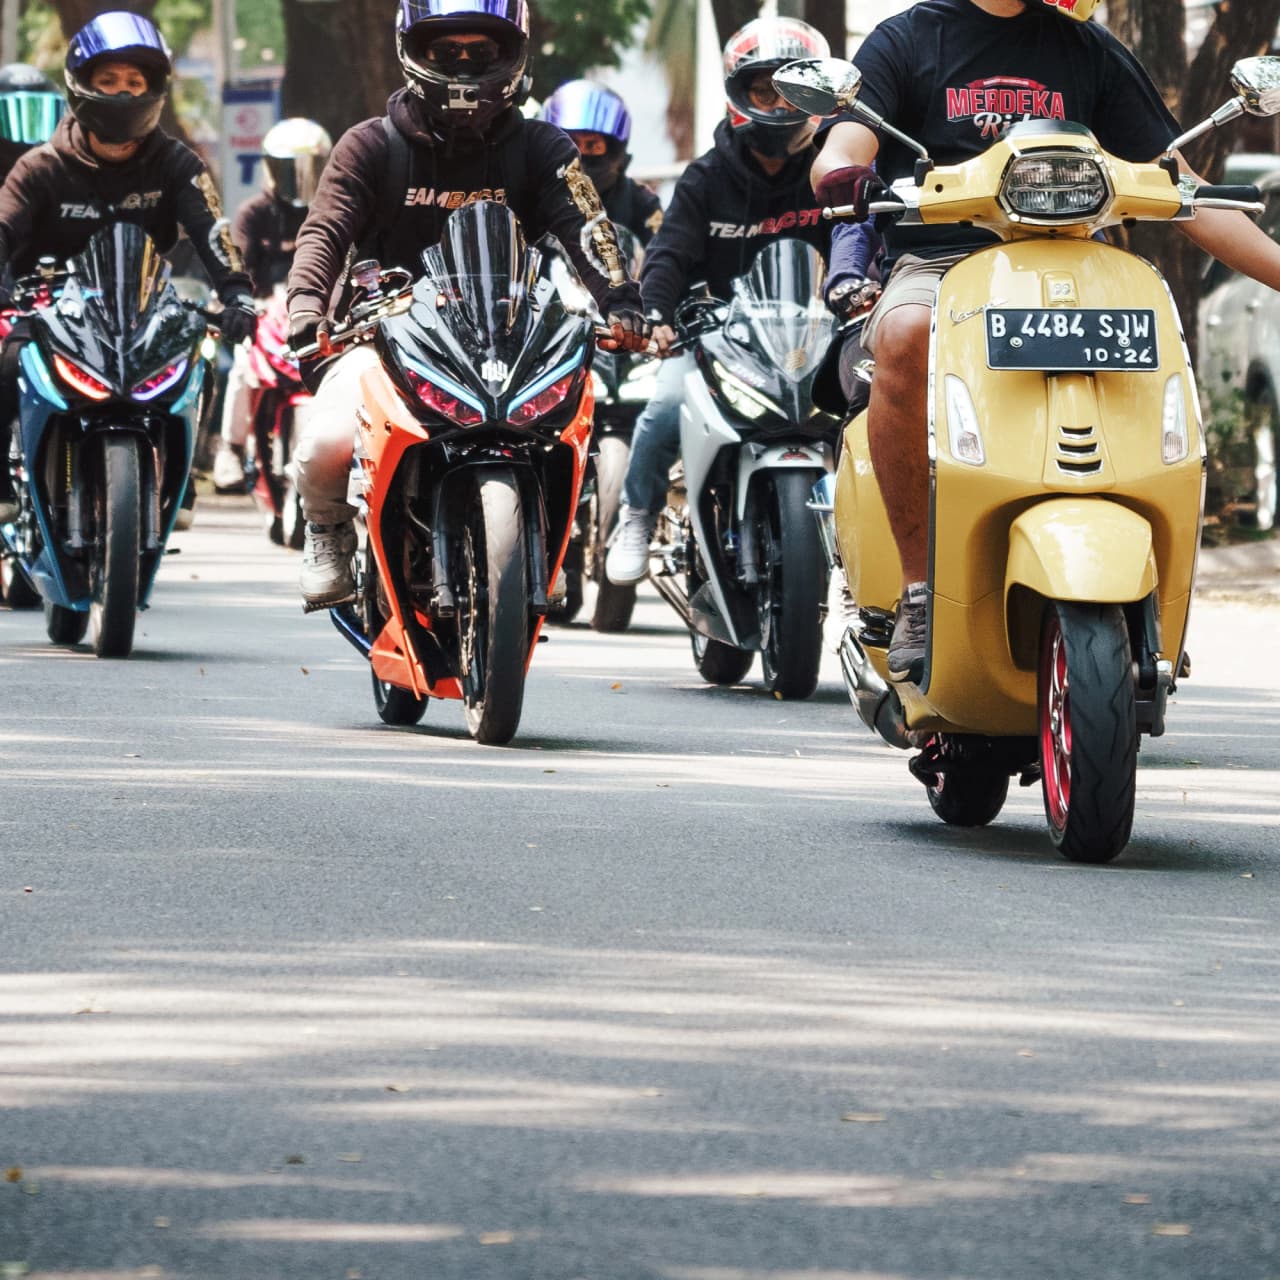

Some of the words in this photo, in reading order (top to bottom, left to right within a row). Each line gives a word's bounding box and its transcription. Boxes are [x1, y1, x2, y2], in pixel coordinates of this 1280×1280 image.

[946, 87, 1066, 121] MERDEKA
[990, 313, 1007, 338] B
[1020, 313, 1085, 338] 4484
[1098, 313, 1150, 338] SJW
